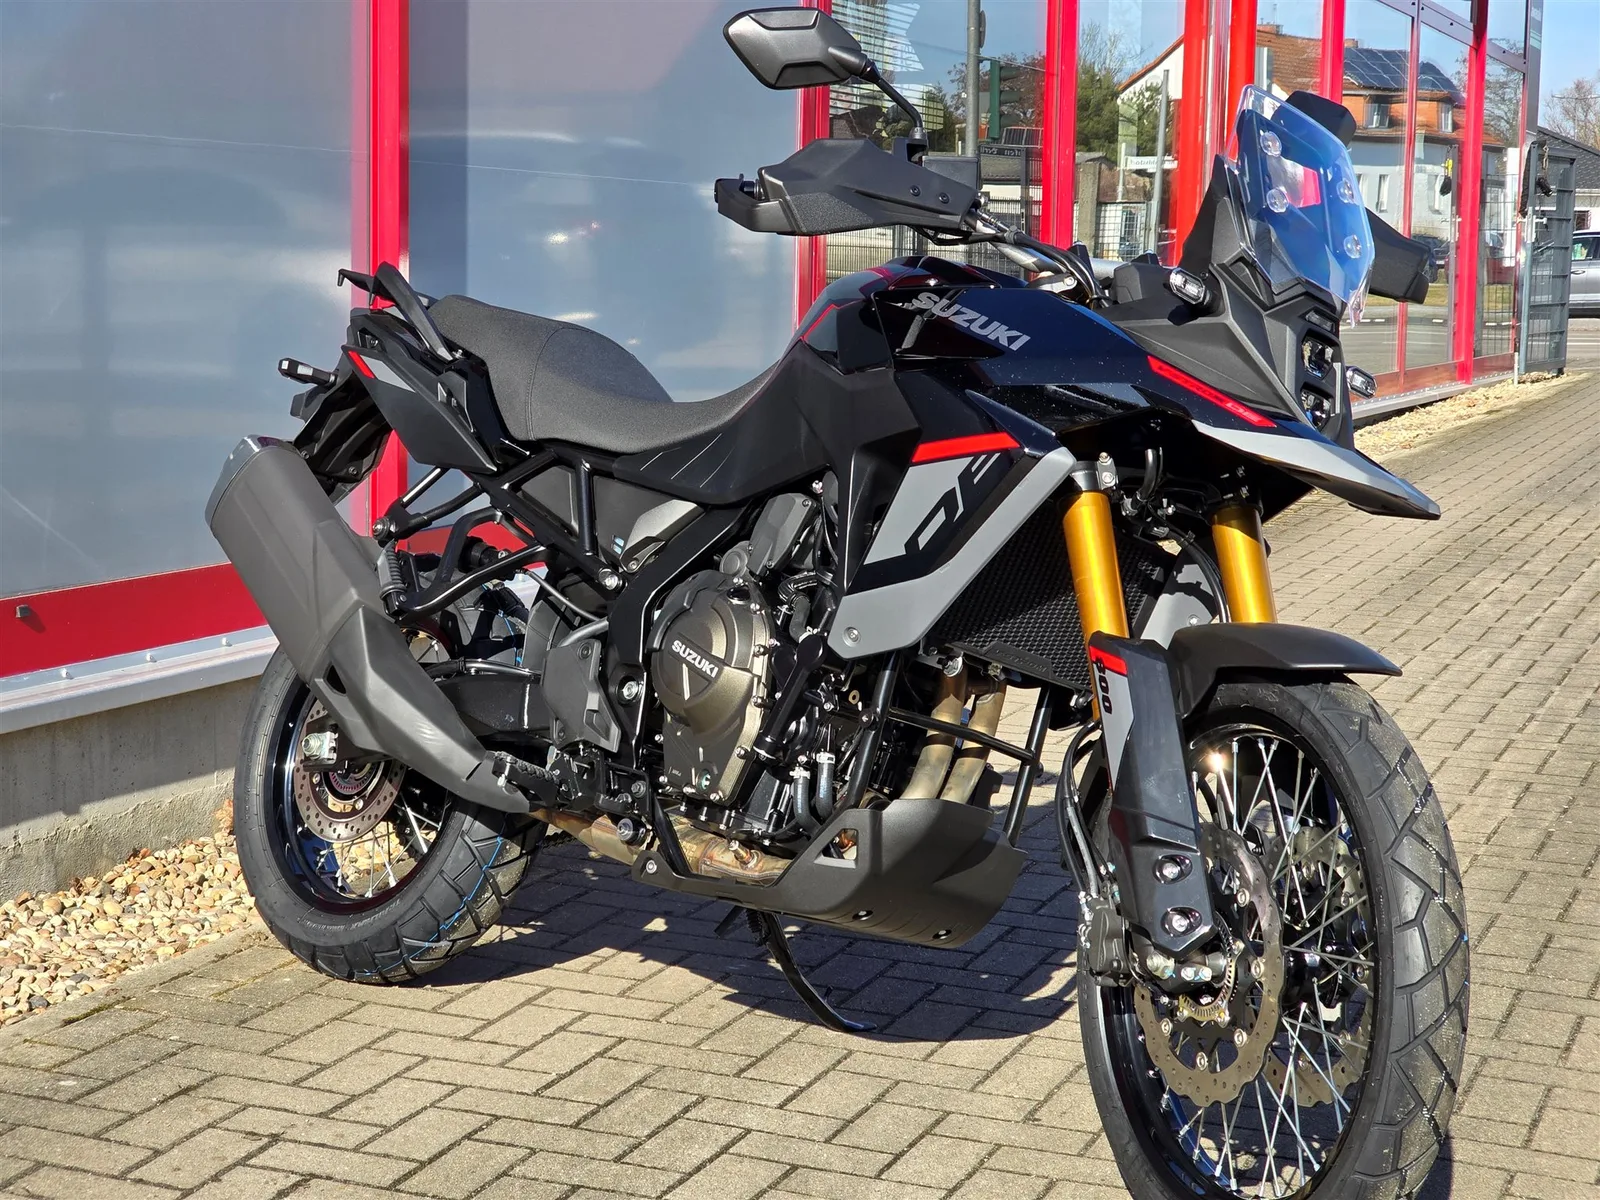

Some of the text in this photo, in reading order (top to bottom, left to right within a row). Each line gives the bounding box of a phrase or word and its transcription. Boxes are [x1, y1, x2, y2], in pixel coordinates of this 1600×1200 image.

[912, 292, 1031, 351] SUZUKI
[671, 639, 719, 678] SUZUKI
[1095, 657, 1113, 715] 800
